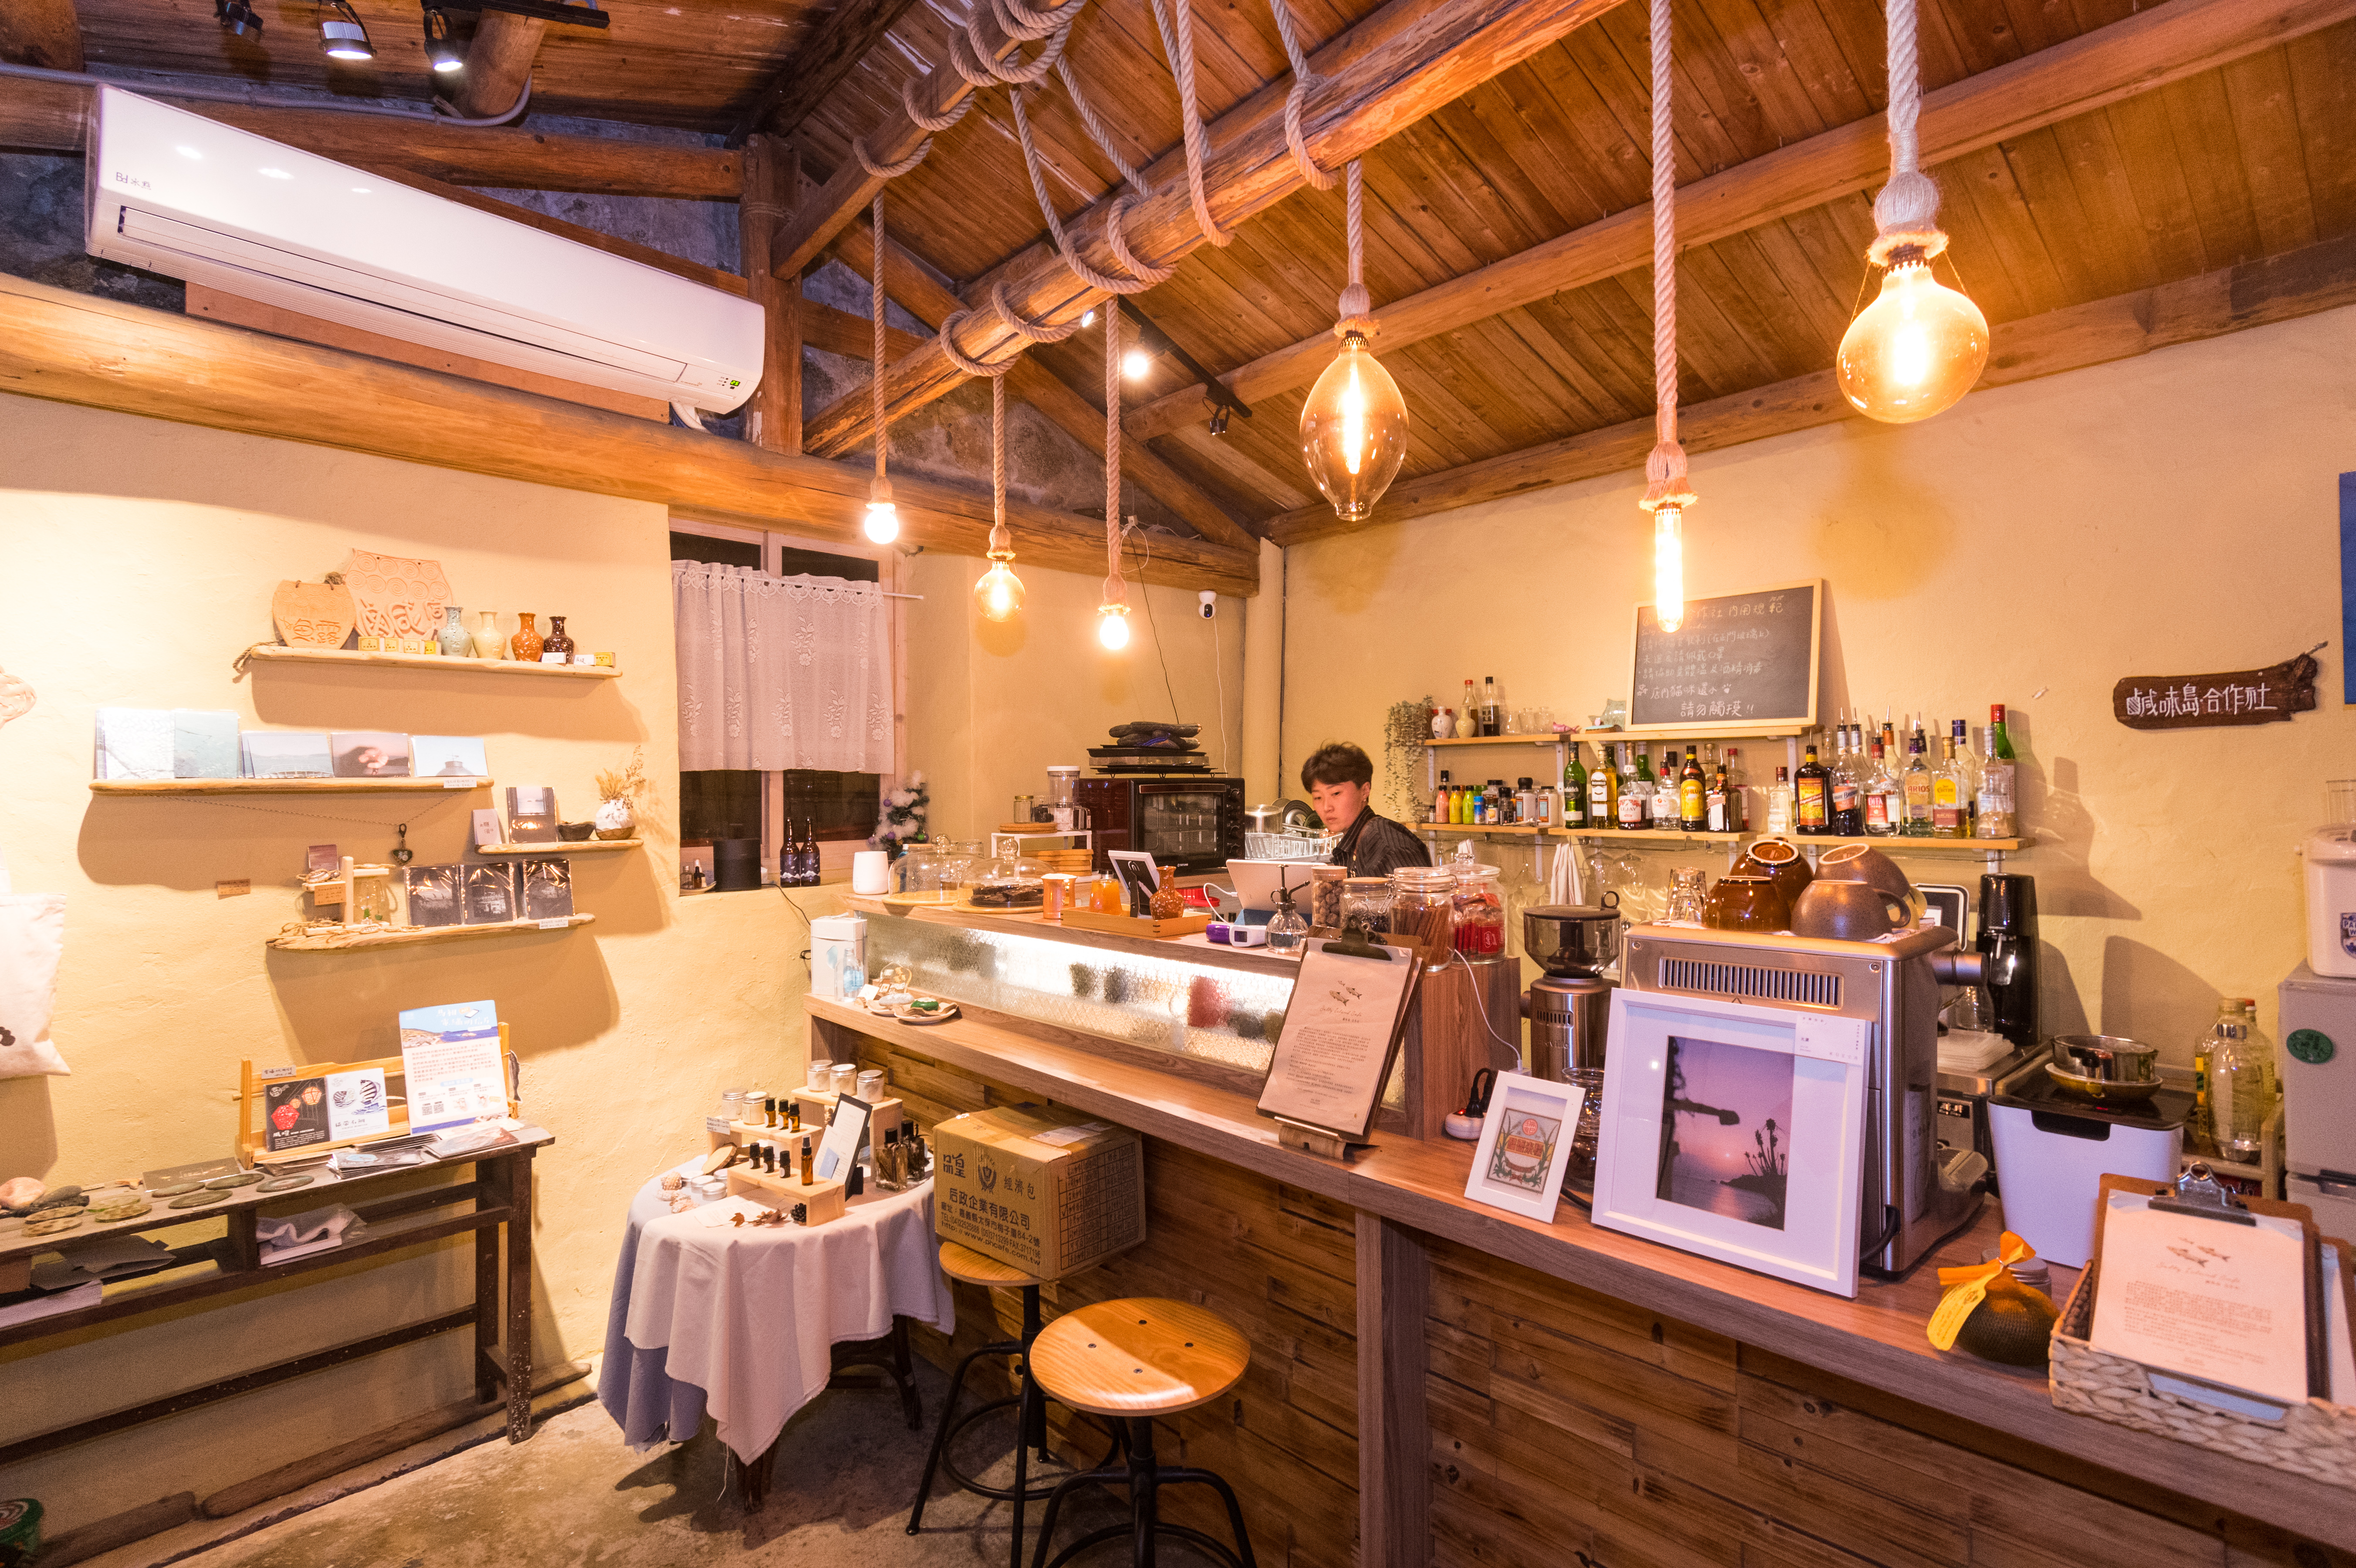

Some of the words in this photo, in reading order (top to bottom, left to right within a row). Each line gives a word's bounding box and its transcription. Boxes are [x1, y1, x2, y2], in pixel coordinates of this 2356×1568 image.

[1868, 798, 1883, 806] DITA
[1004, 1176, 1036, 1200] 經濟包
[949, 1188, 1029, 1230] 后政企業有限公司
